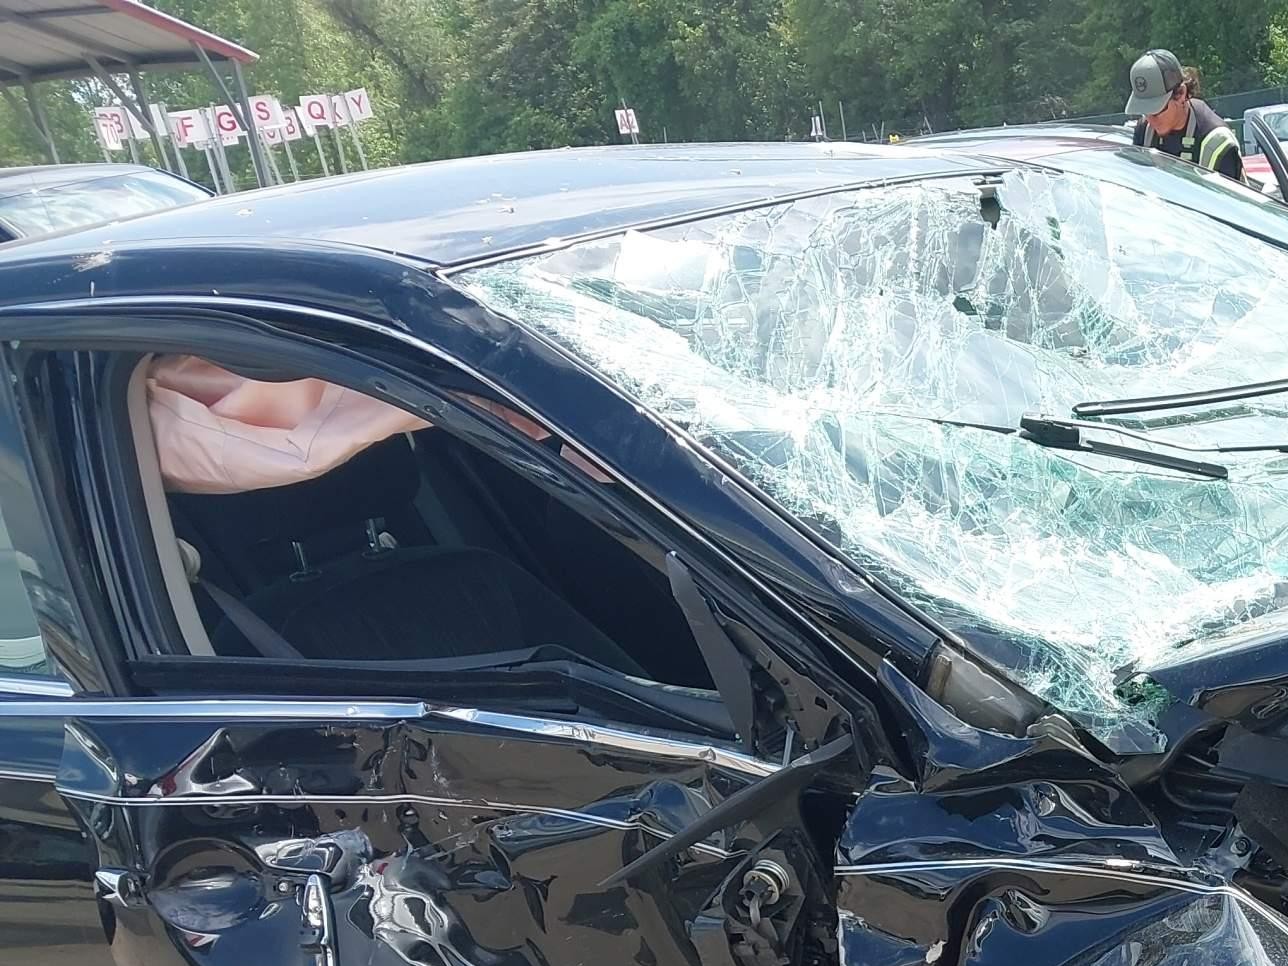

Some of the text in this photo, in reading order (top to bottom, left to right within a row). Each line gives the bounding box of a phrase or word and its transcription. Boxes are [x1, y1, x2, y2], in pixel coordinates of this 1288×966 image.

[255, 101, 270, 121] S
[307, 100, 327, 120] Q
[351, 94, 363, 114] Y
[181, 116, 194, 137] F
[217, 112, 237, 131] G
